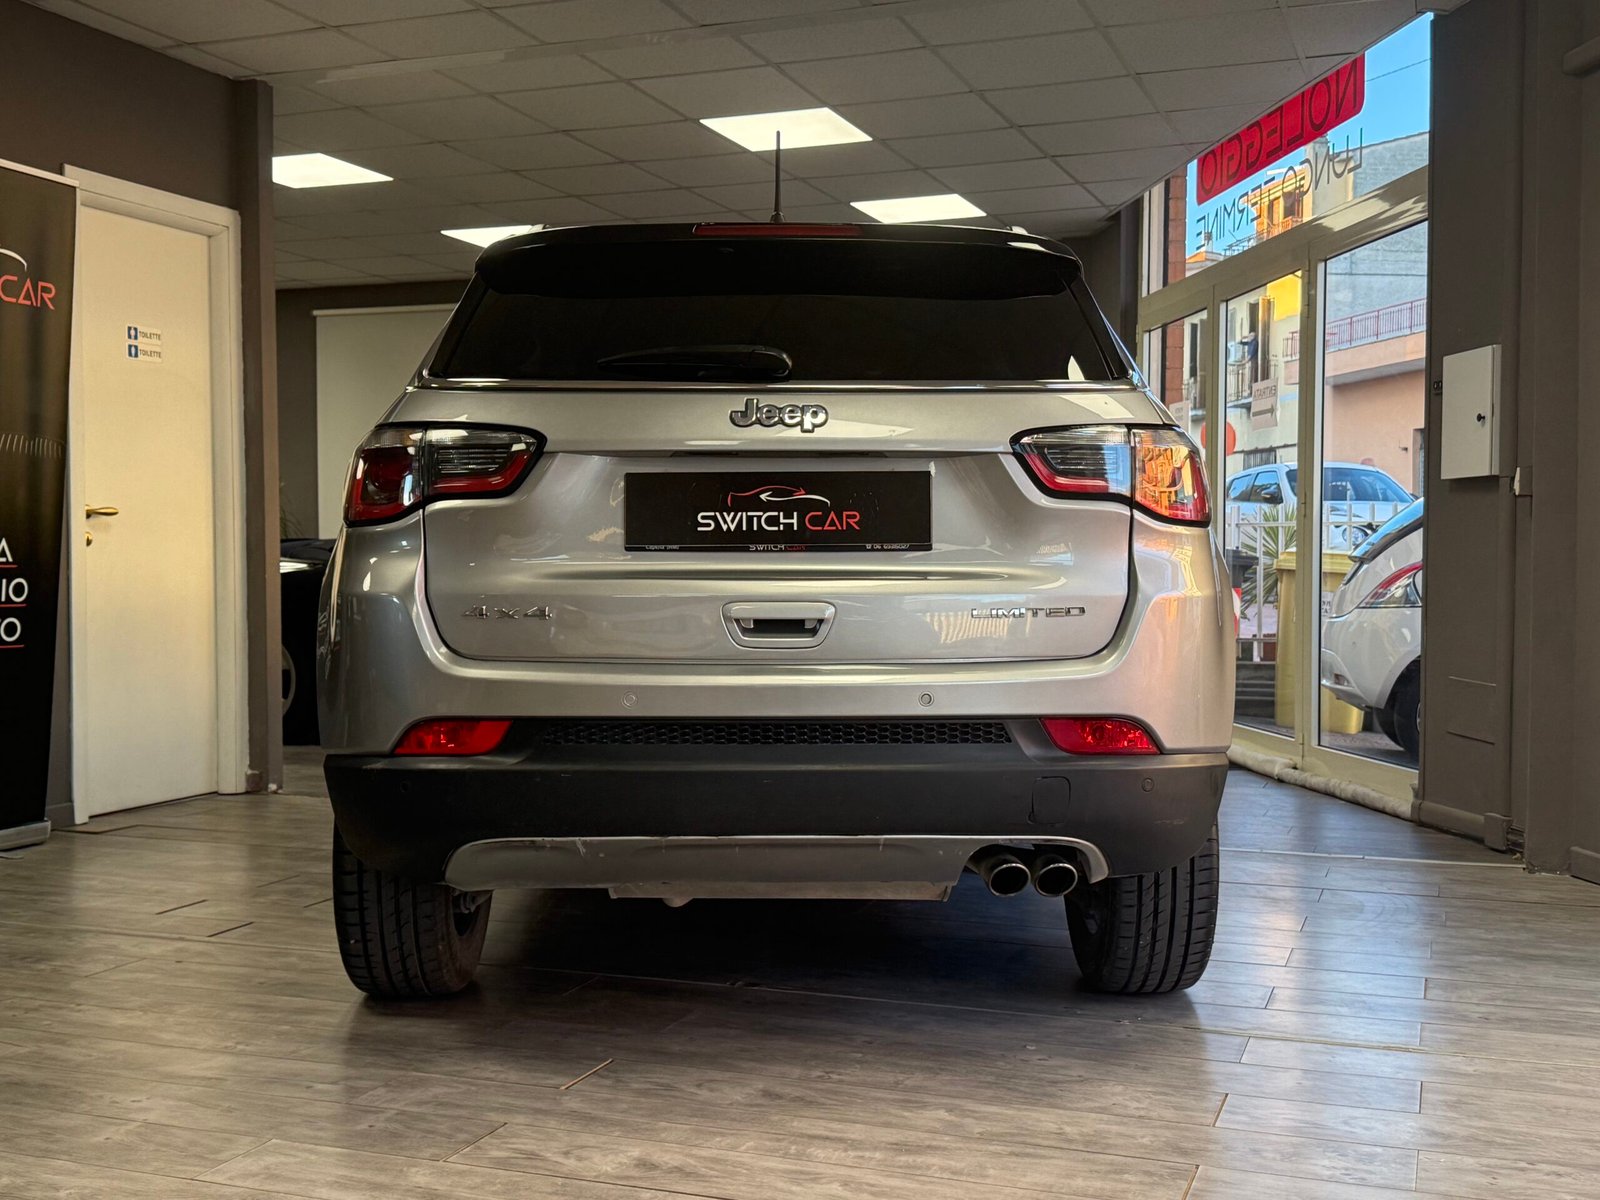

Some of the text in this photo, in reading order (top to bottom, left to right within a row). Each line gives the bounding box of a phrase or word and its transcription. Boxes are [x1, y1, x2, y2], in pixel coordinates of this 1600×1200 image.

[0, 275, 56, 310] CAR
[139, 331, 161, 340] TOILETTE
[139, 349, 162, 358] TOILETTE
[729, 397, 829, 433] Jeep
[697, 511, 860, 532] SWITCH CAR
[971, 606, 1086, 619] LIMITED
